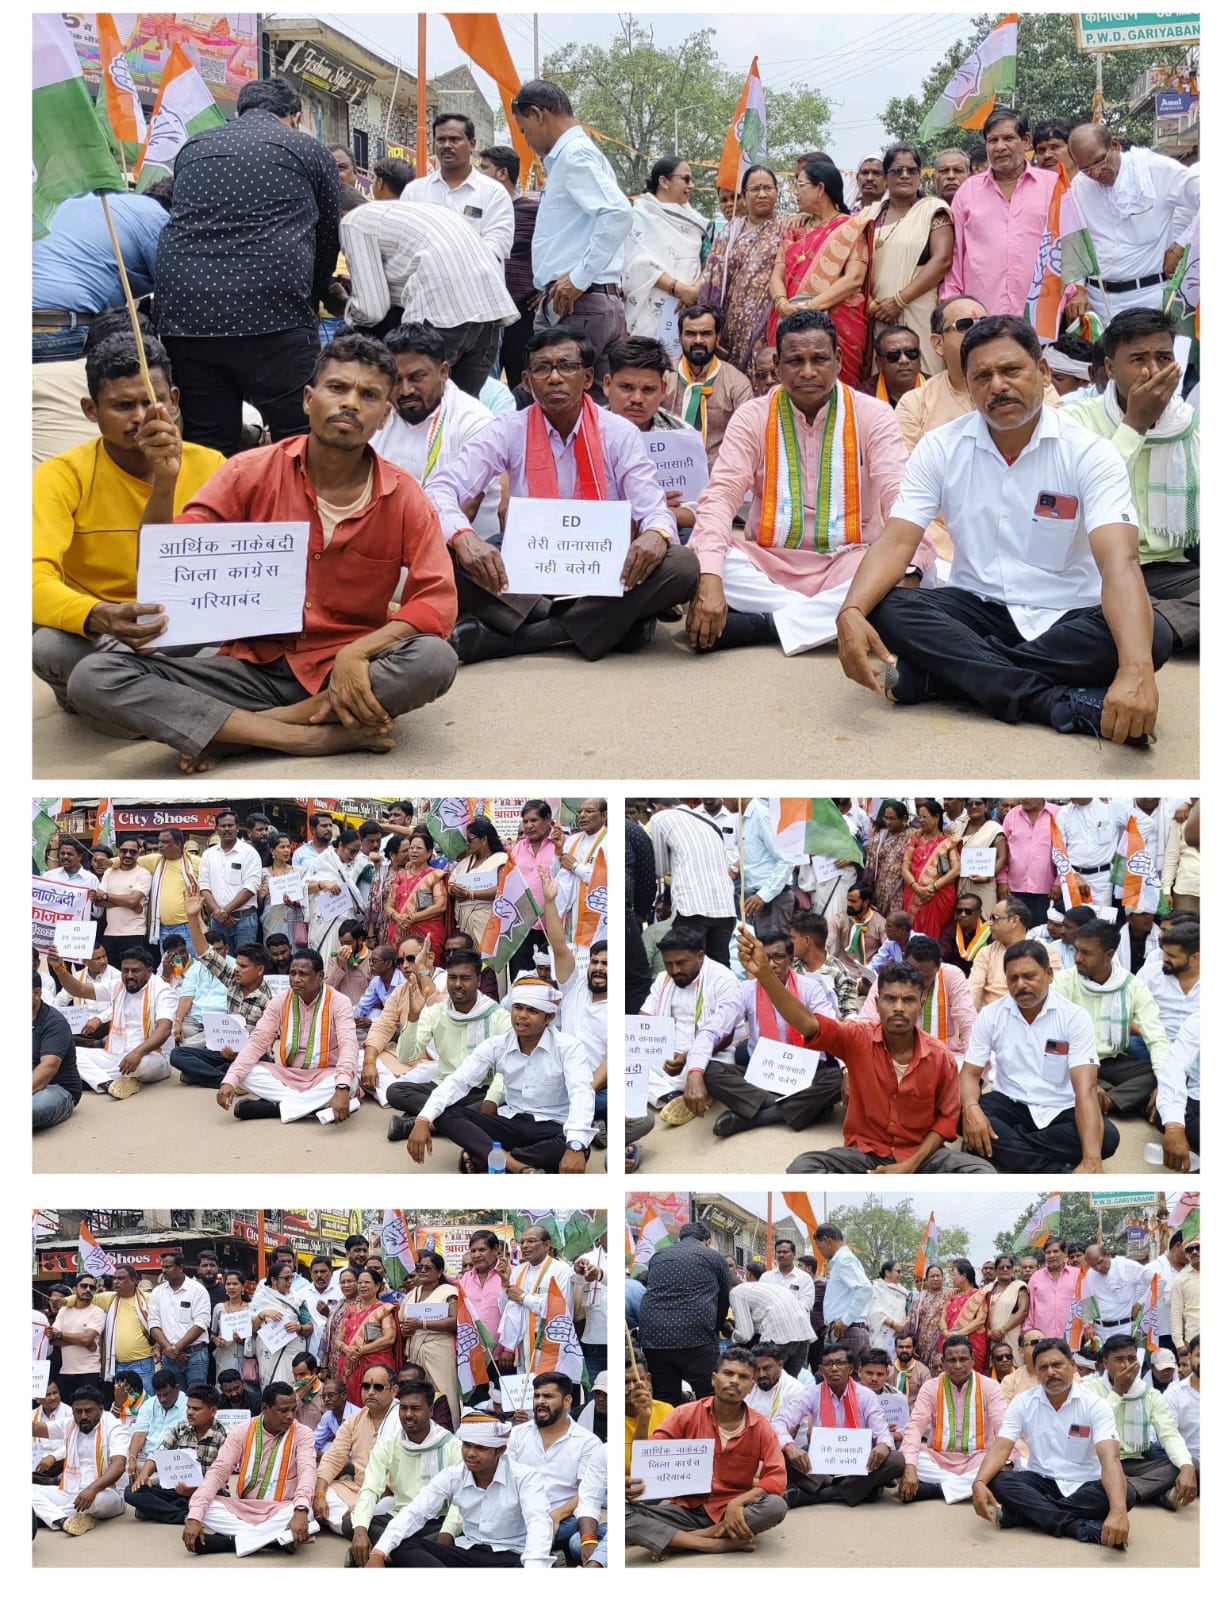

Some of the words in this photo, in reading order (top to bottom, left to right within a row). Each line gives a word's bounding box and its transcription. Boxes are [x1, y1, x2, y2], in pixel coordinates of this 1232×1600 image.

[1086, 31, 1126, 43] P.W.D.
[650, 442, 666, 453] ED
[562, 515, 582, 528] ED
[160, 536, 220, 555] आर्थिक
[231, 533, 295, 552] नाकेबंदी
[527, 536, 549, 550] तेरी
[557, 538, 613, 552] तानासाही
[174, 565, 218, 583] जिला
[228, 561, 279, 580] कांग्रेस
[535, 560, 556, 574] नही
[565, 560, 601, 575] चलेगी
[191, 590, 262, 610] गरियाबंद
[118, 812, 148, 827] City
[152, 811, 198, 826] Shoes
[782, 1051, 793, 1060] ED
[107, 1251, 151, 1265] Shoes
